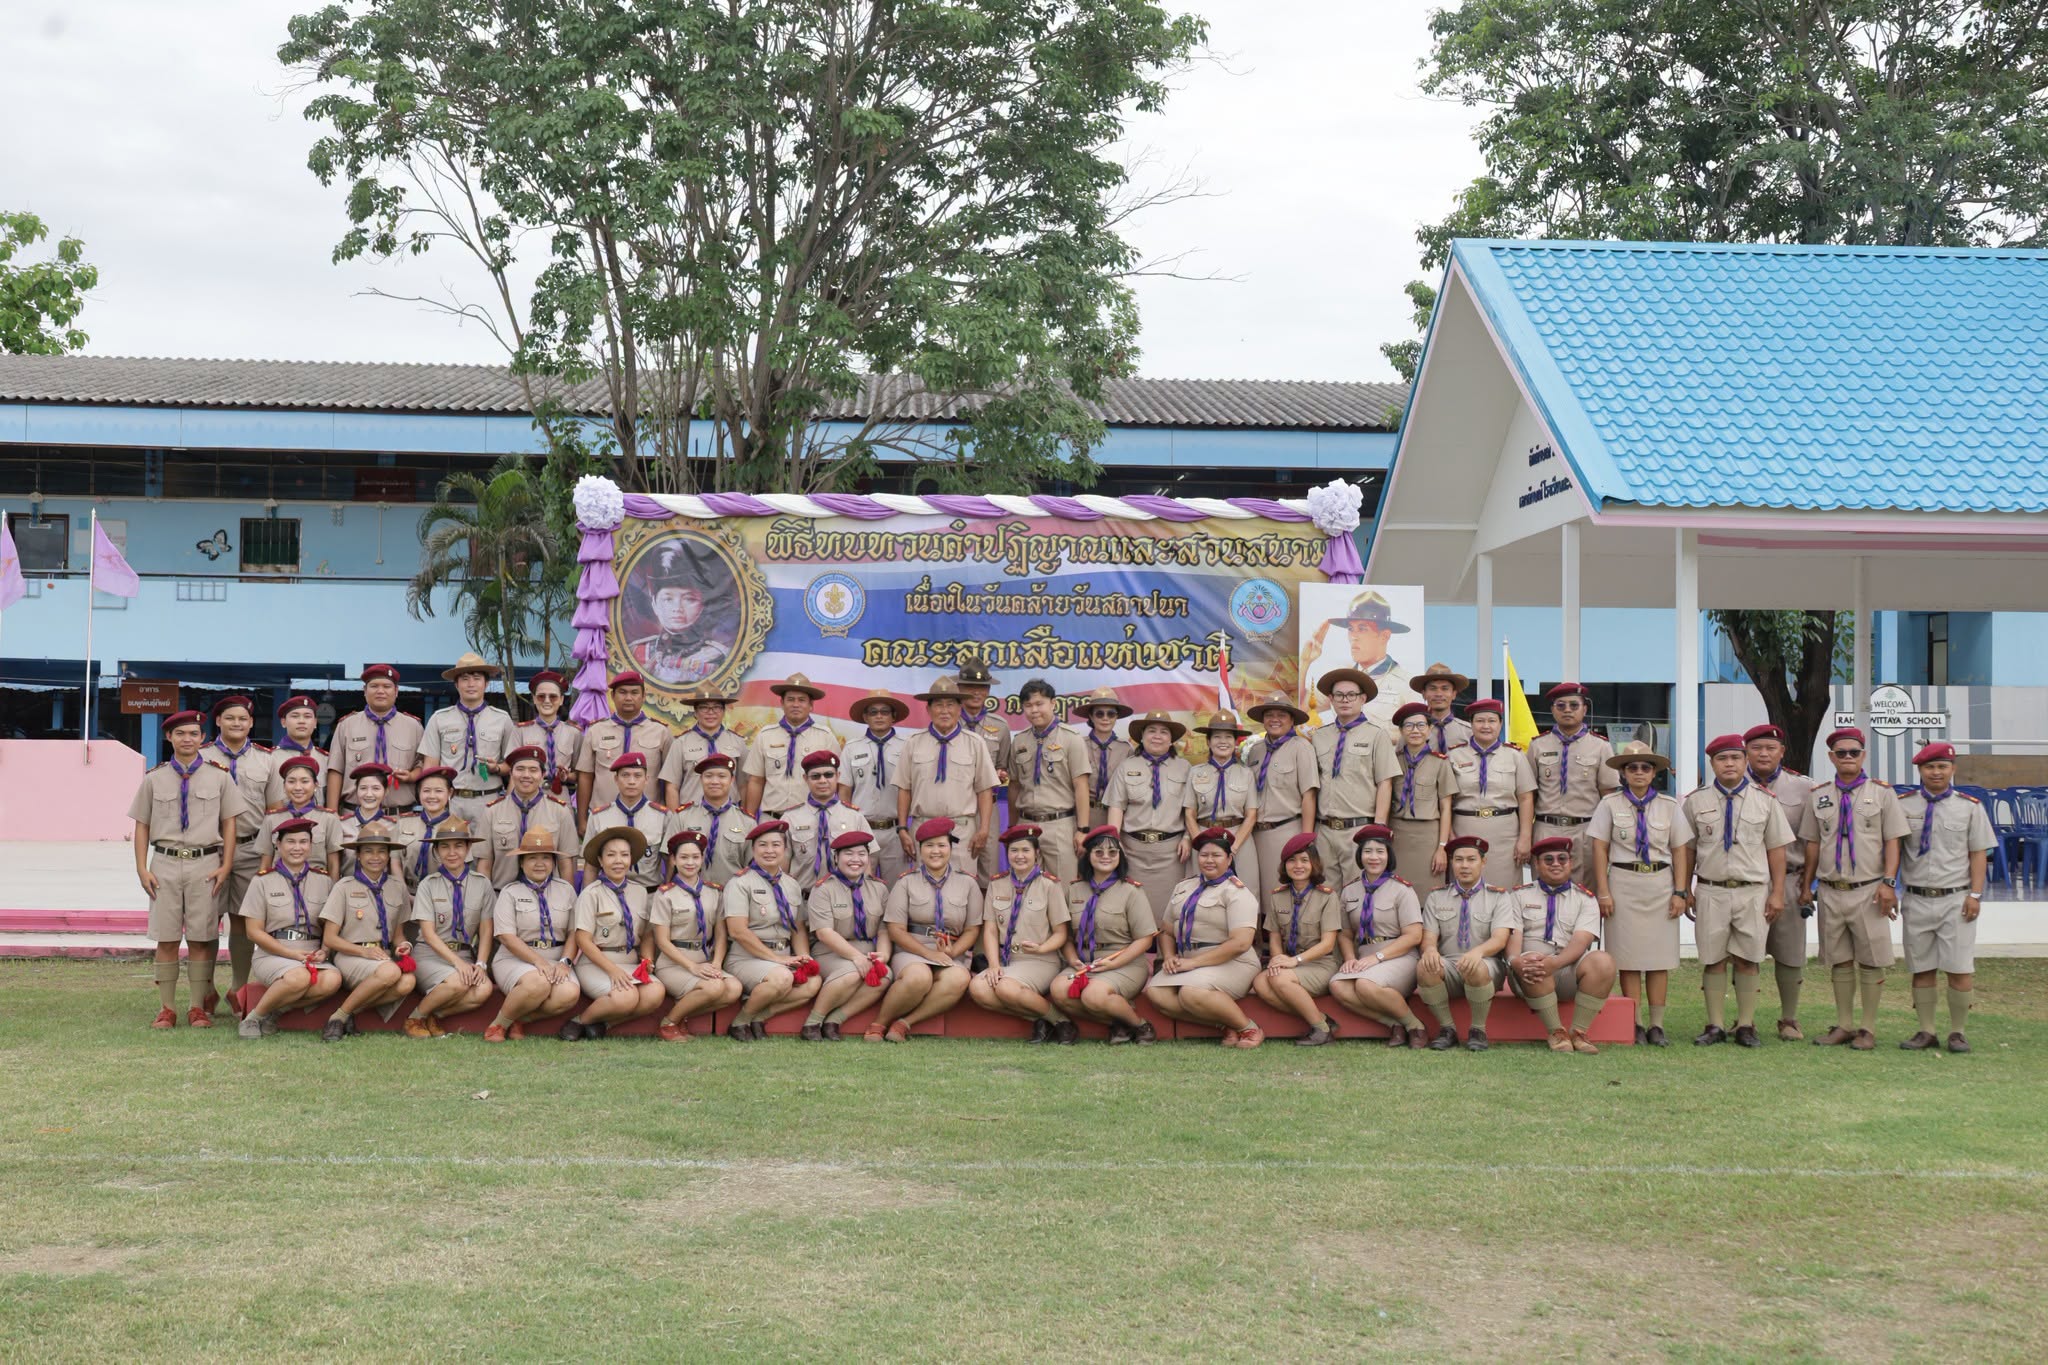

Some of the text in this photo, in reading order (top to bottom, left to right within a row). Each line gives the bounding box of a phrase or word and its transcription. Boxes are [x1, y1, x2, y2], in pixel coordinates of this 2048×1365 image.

[905, 575, 1189, 618] เนื่องในวันคล้ายวันสถาปนา
[861, 624, 1234, 671] คณะลกเสือแห่งชาติ
[1886, 708, 1896, 716] TO
[1906, 715, 1942, 725] SCHOOL
